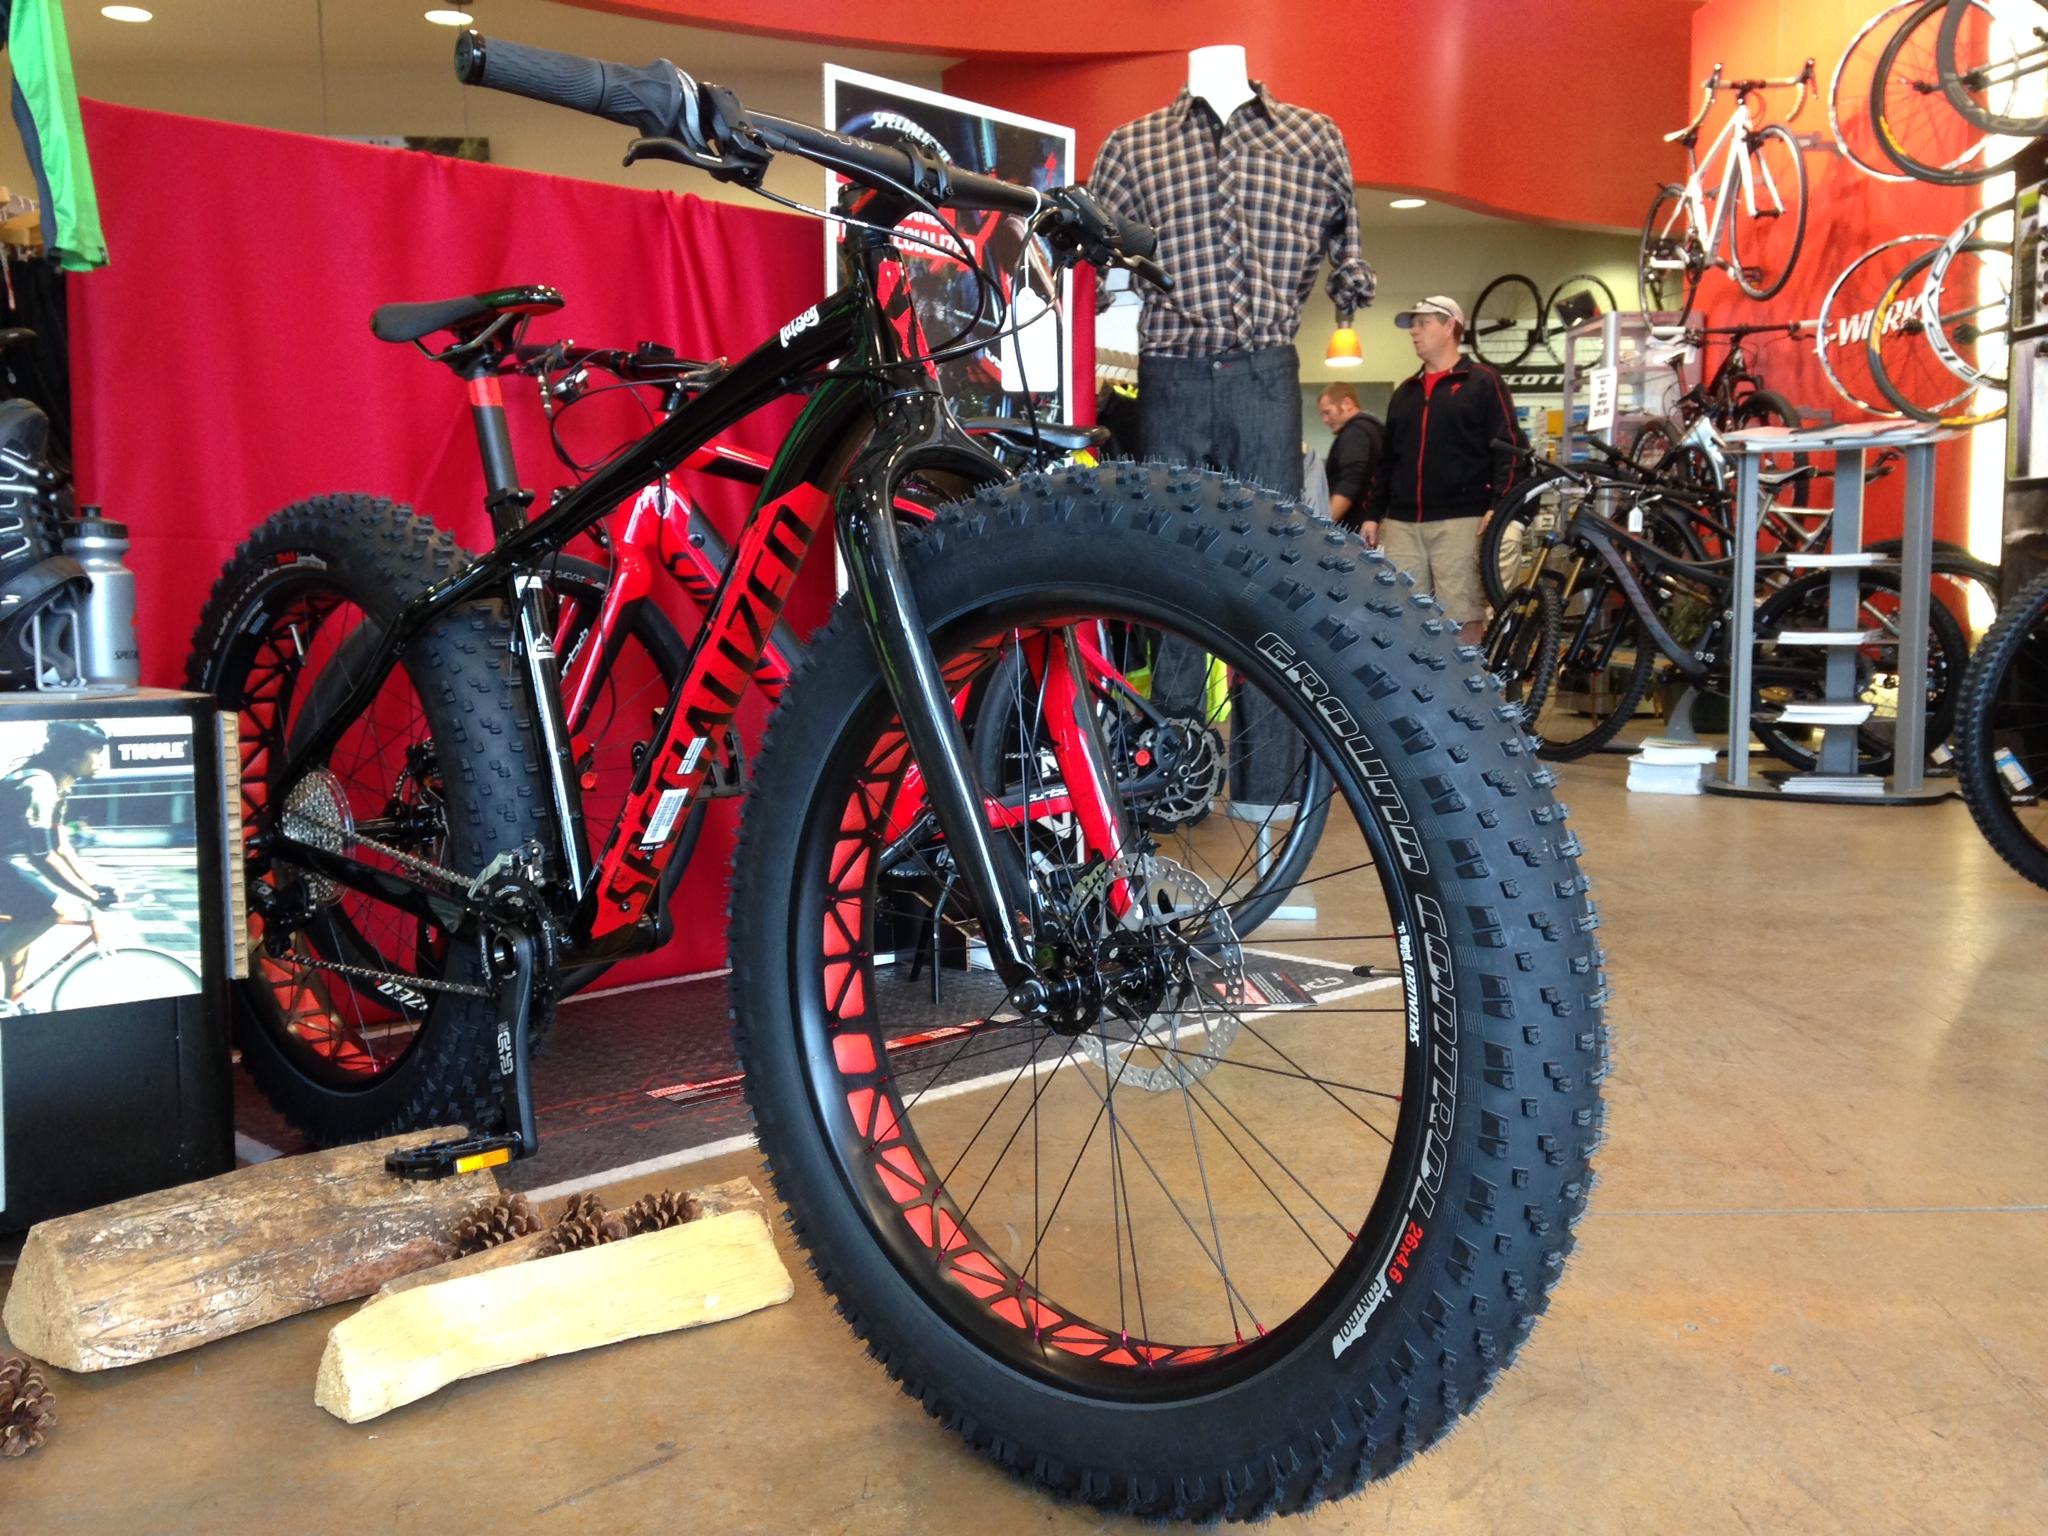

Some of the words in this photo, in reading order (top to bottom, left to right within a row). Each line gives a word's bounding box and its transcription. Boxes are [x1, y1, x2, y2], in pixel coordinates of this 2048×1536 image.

[1501, 373, 1564, 386] SCOTT
[117, 741, 187, 761] THULE
[1254, 631, 1430, 875] GROUND
[1409, 893, 1459, 1219] CONTROL
[1404, 962, 1420, 1048] SPECIALIZED
[1388, 1220, 1425, 1285] 26x4.6
